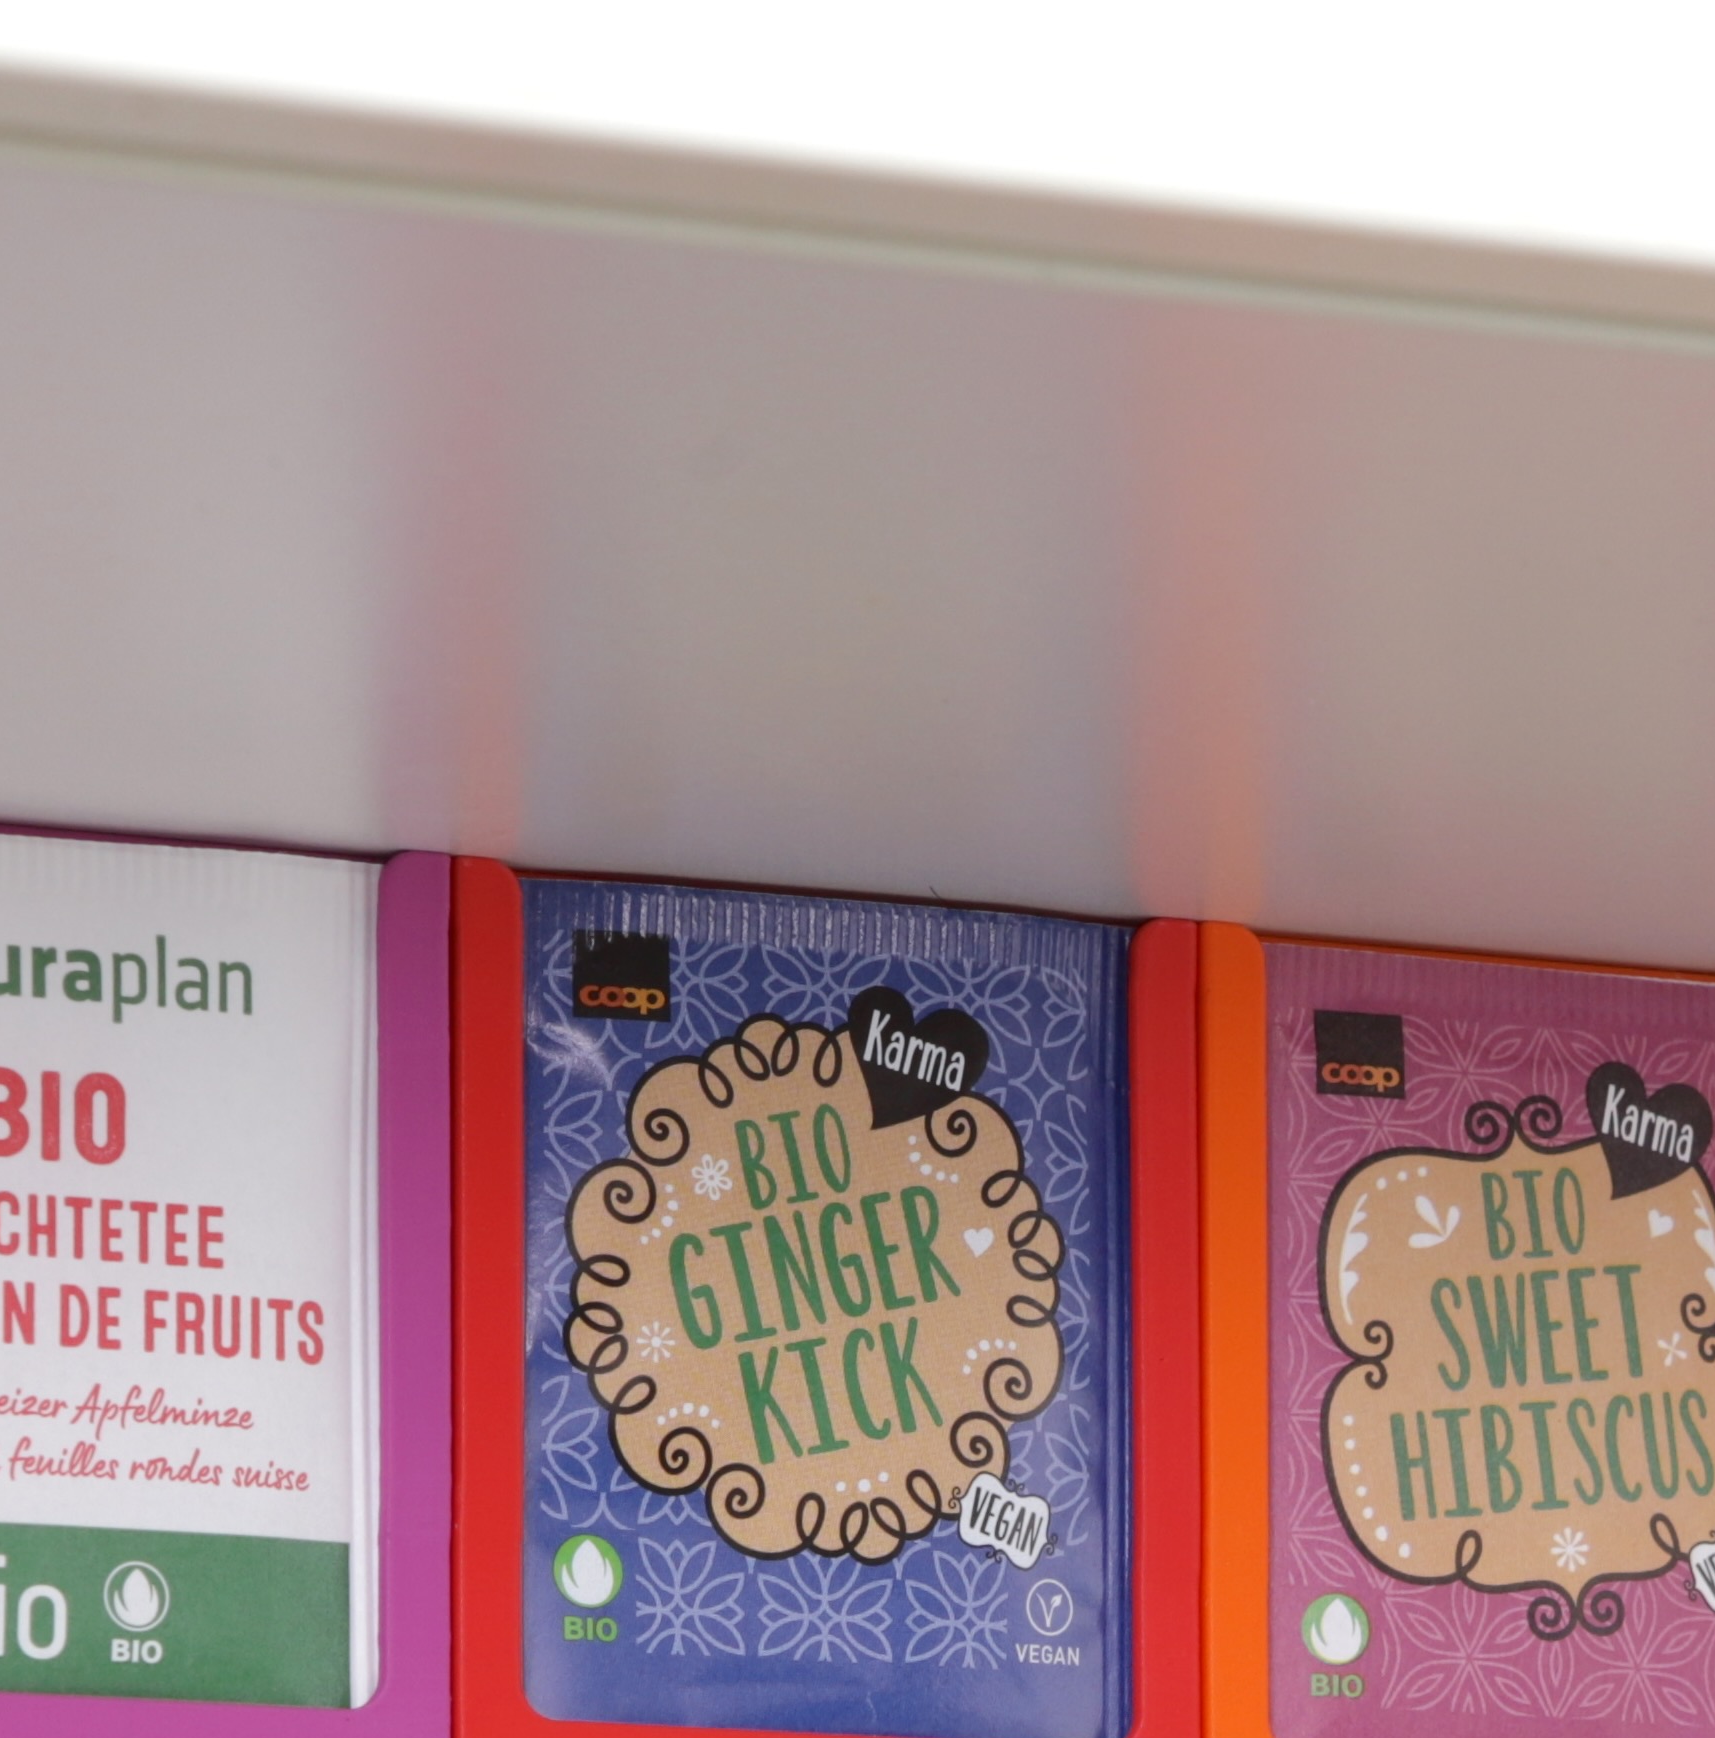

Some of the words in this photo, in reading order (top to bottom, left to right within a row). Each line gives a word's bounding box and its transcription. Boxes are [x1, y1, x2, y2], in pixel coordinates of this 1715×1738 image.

[578, 982, 666, 1016] coop
[861, 1008, 967, 1093] Karma
[1321, 1060, 1401, 1092] coop
[733, 1103, 852, 1211] BIO
[1600, 1083, 1696, 1163] Karma
[1480, 1166, 1585, 1261] BIO
[667, 1184, 962, 1350] GINGER
[58, 1282, 123, 1350] DE
[143, 1289, 325, 1365] FRUITS
[1429, 1263, 1645, 1392] SWEET
[69, 1382, 255, 1441] Apfelminze
[737, 1315, 944, 1465] KICK
[8, 1435, 119, 1481] feuilles
[128, 1447, 224, 1487] rondes
[231, 1459, 311, 1492] suisse
[967, 1486, 1047, 1560] VEGAN
[109, 1638, 164, 1665] BIO
[562, 1615, 619, 1643] BIO
[1014, 1643, 1081, 1667] VEGAN
[1310, 1673, 1365, 1699] BIO
